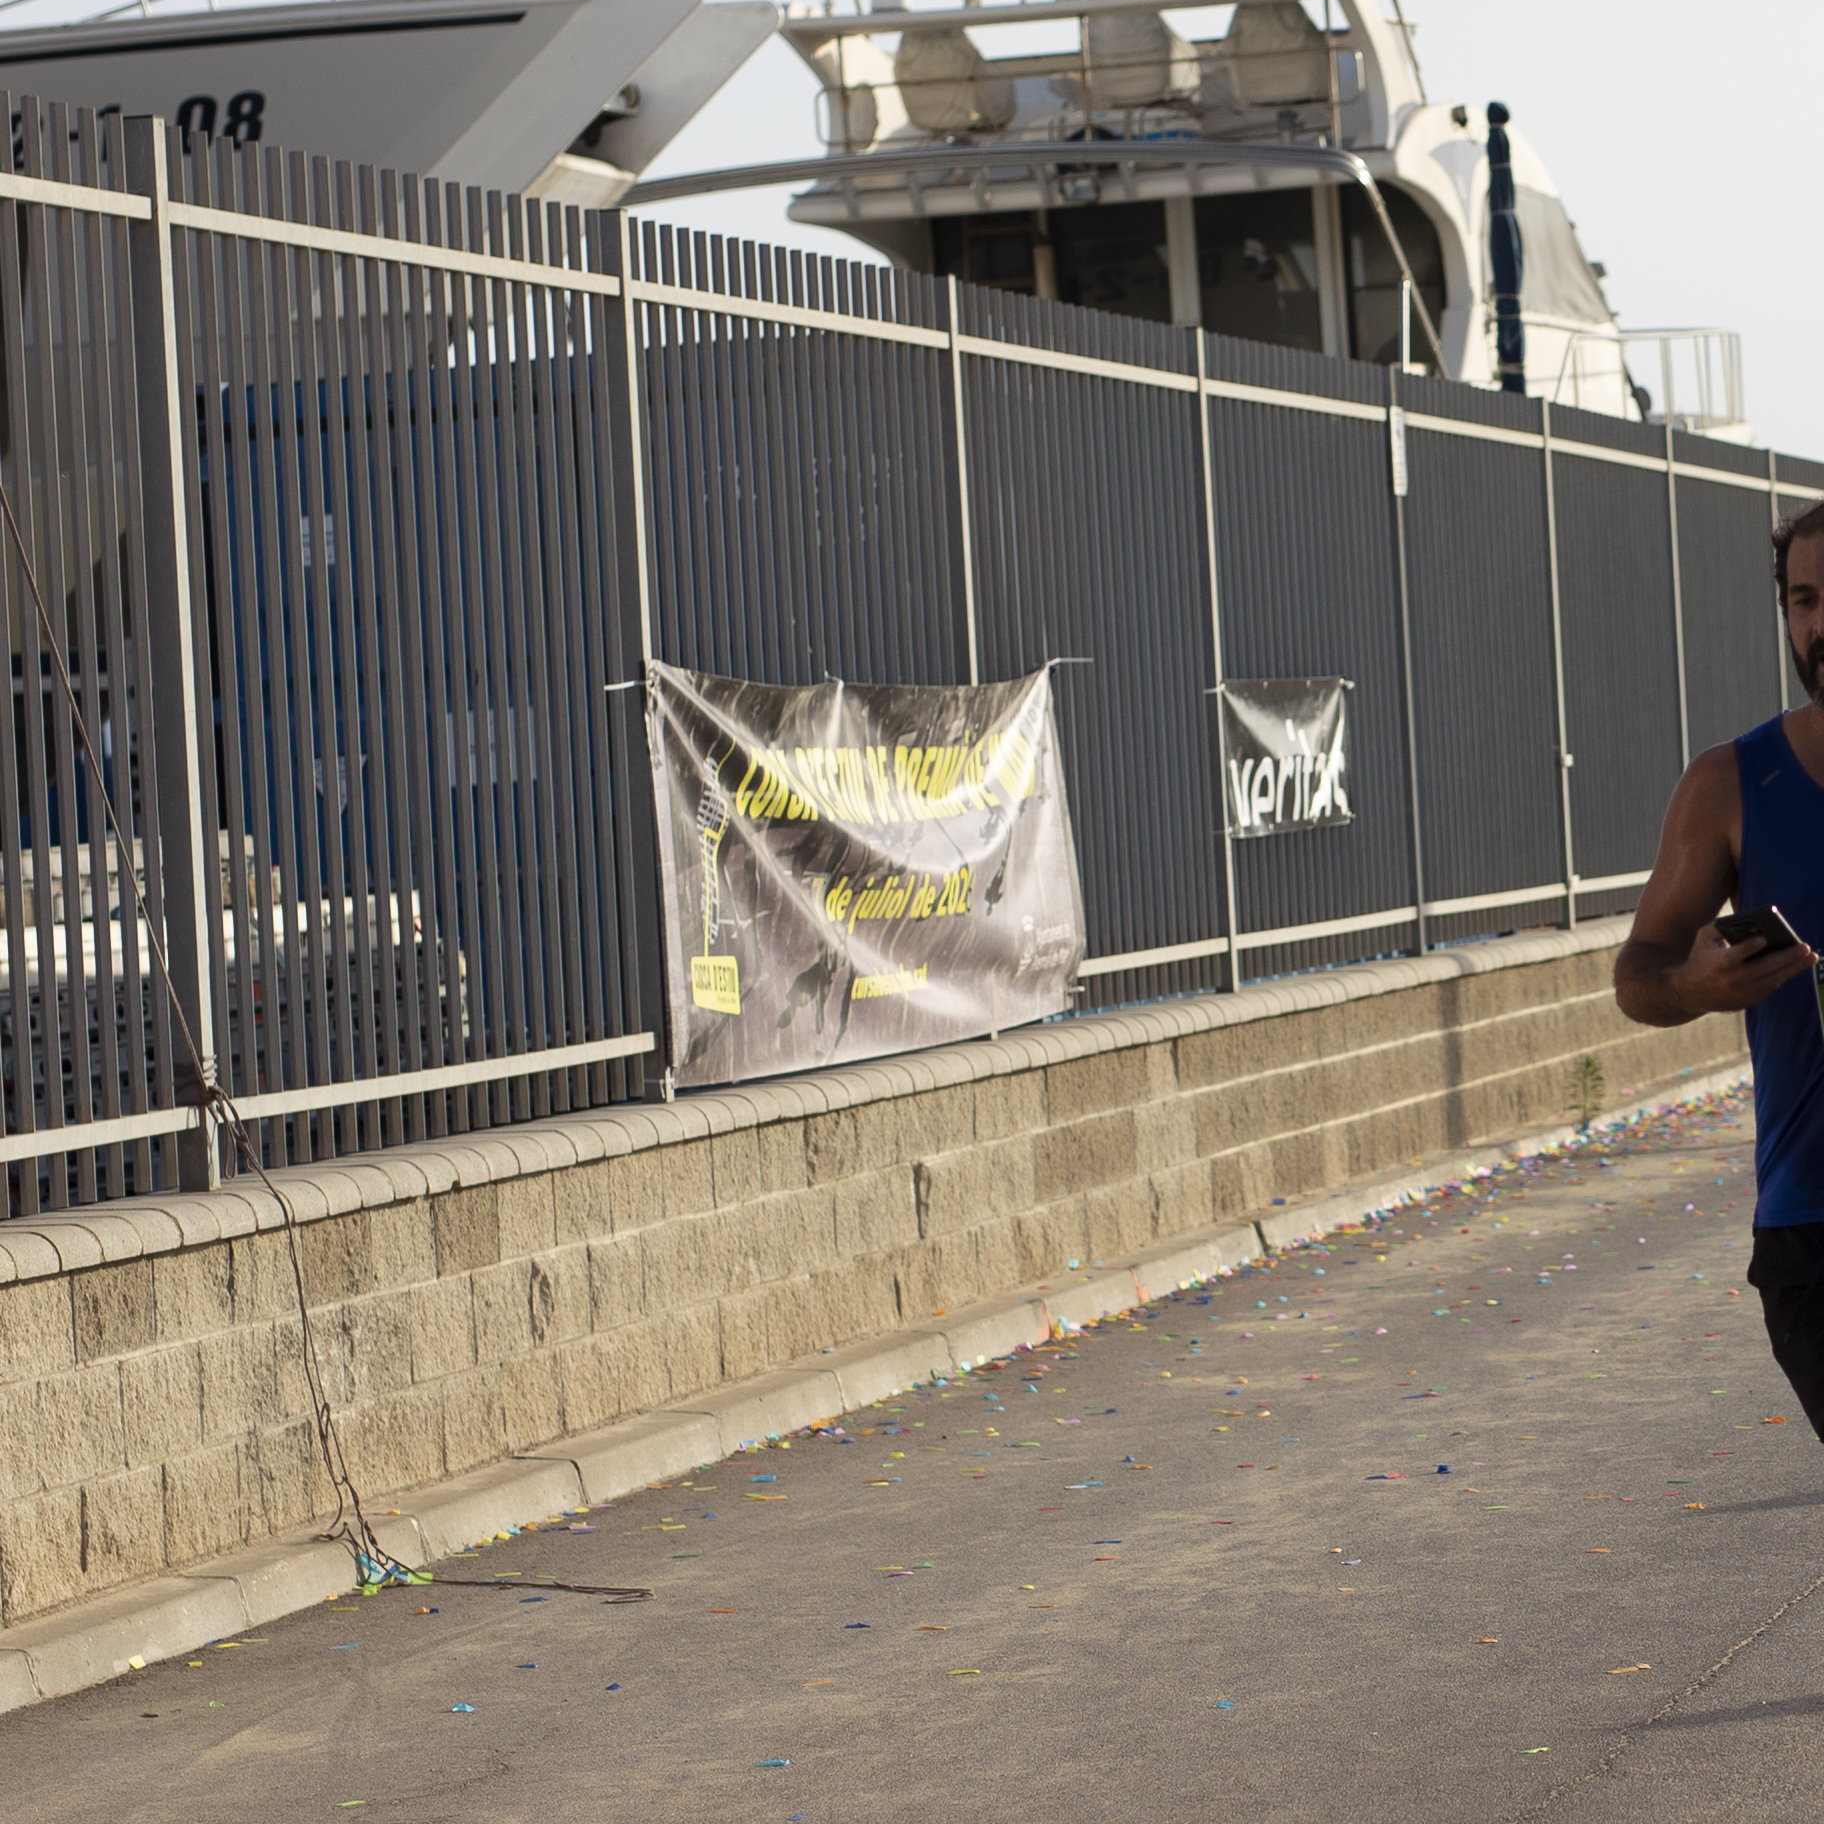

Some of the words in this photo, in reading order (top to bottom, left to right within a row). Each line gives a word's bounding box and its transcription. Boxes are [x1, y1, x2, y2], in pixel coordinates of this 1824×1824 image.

[826, 876, 853, 923] de
[847, 875, 916, 935] juliol
[909, 873, 937, 919] de
